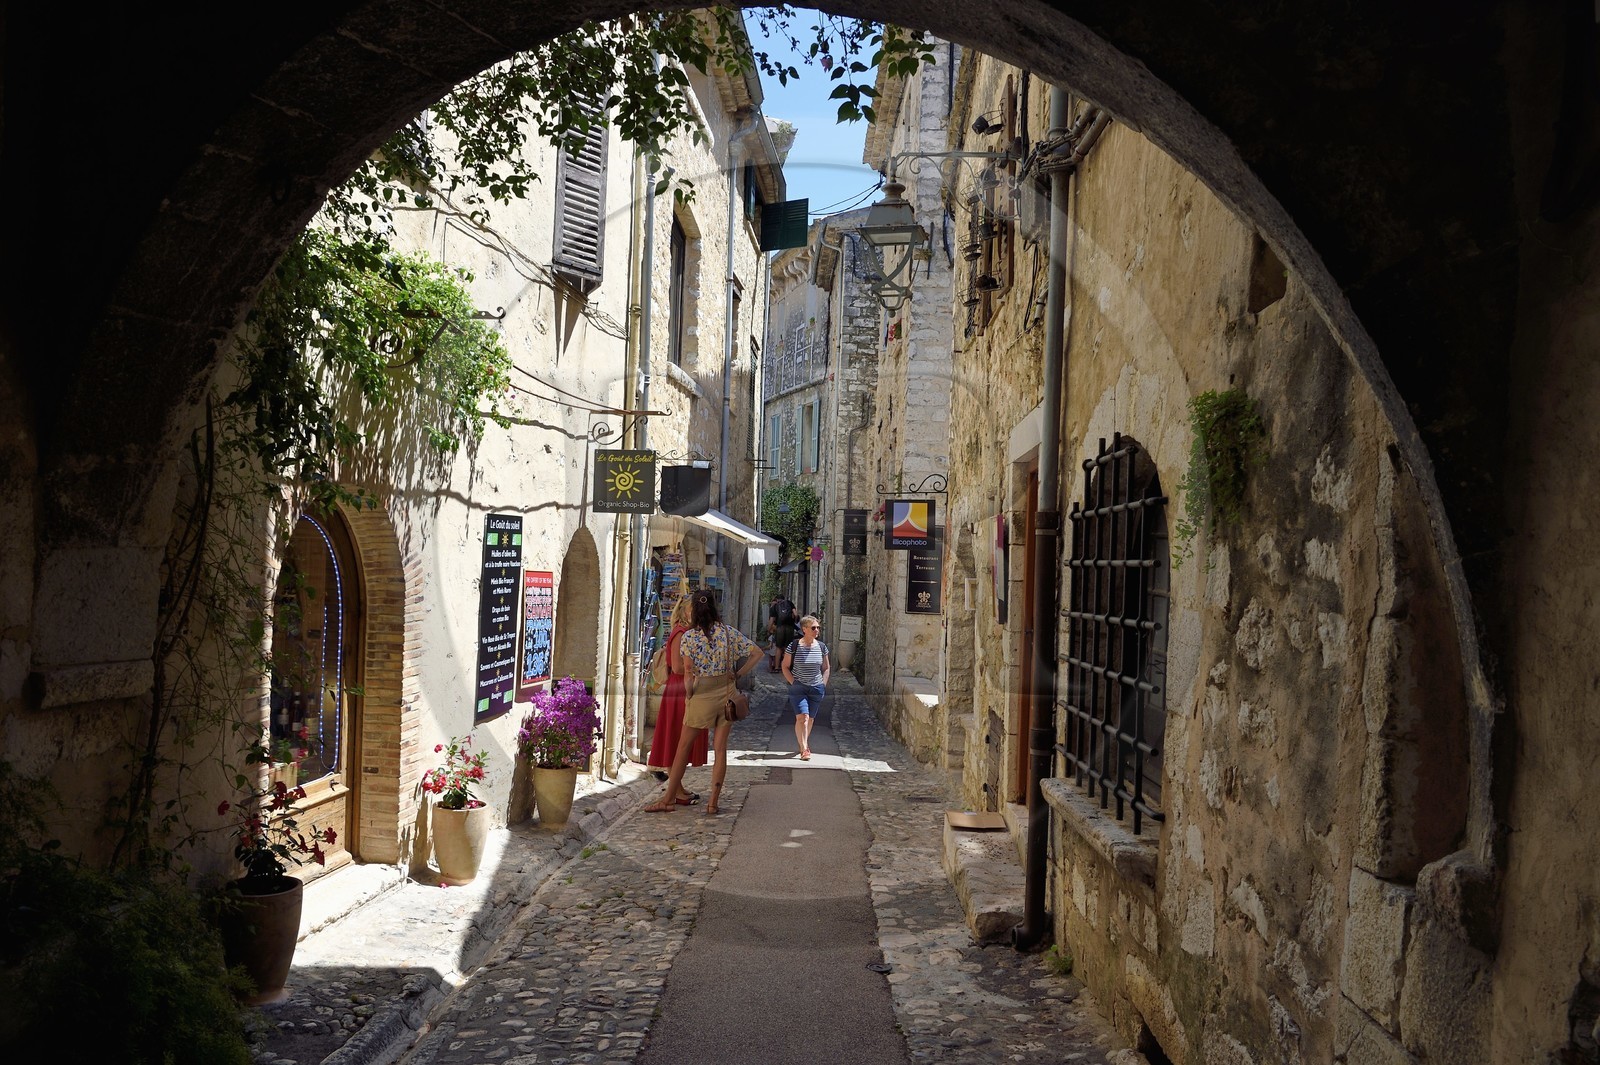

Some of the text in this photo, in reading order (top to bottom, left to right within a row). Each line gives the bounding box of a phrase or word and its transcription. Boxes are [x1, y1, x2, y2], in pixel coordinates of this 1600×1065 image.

[597, 453, 607, 462] Le
[633, 454, 654, 463] Soleil
[597, 500, 650, 508] Organic Shop-Bio
[490, 519, 495, 529] Le
[505, 520, 510, 529] du
[510, 521, 520, 530] soleil
[892, 538, 928, 547] illicophoto
